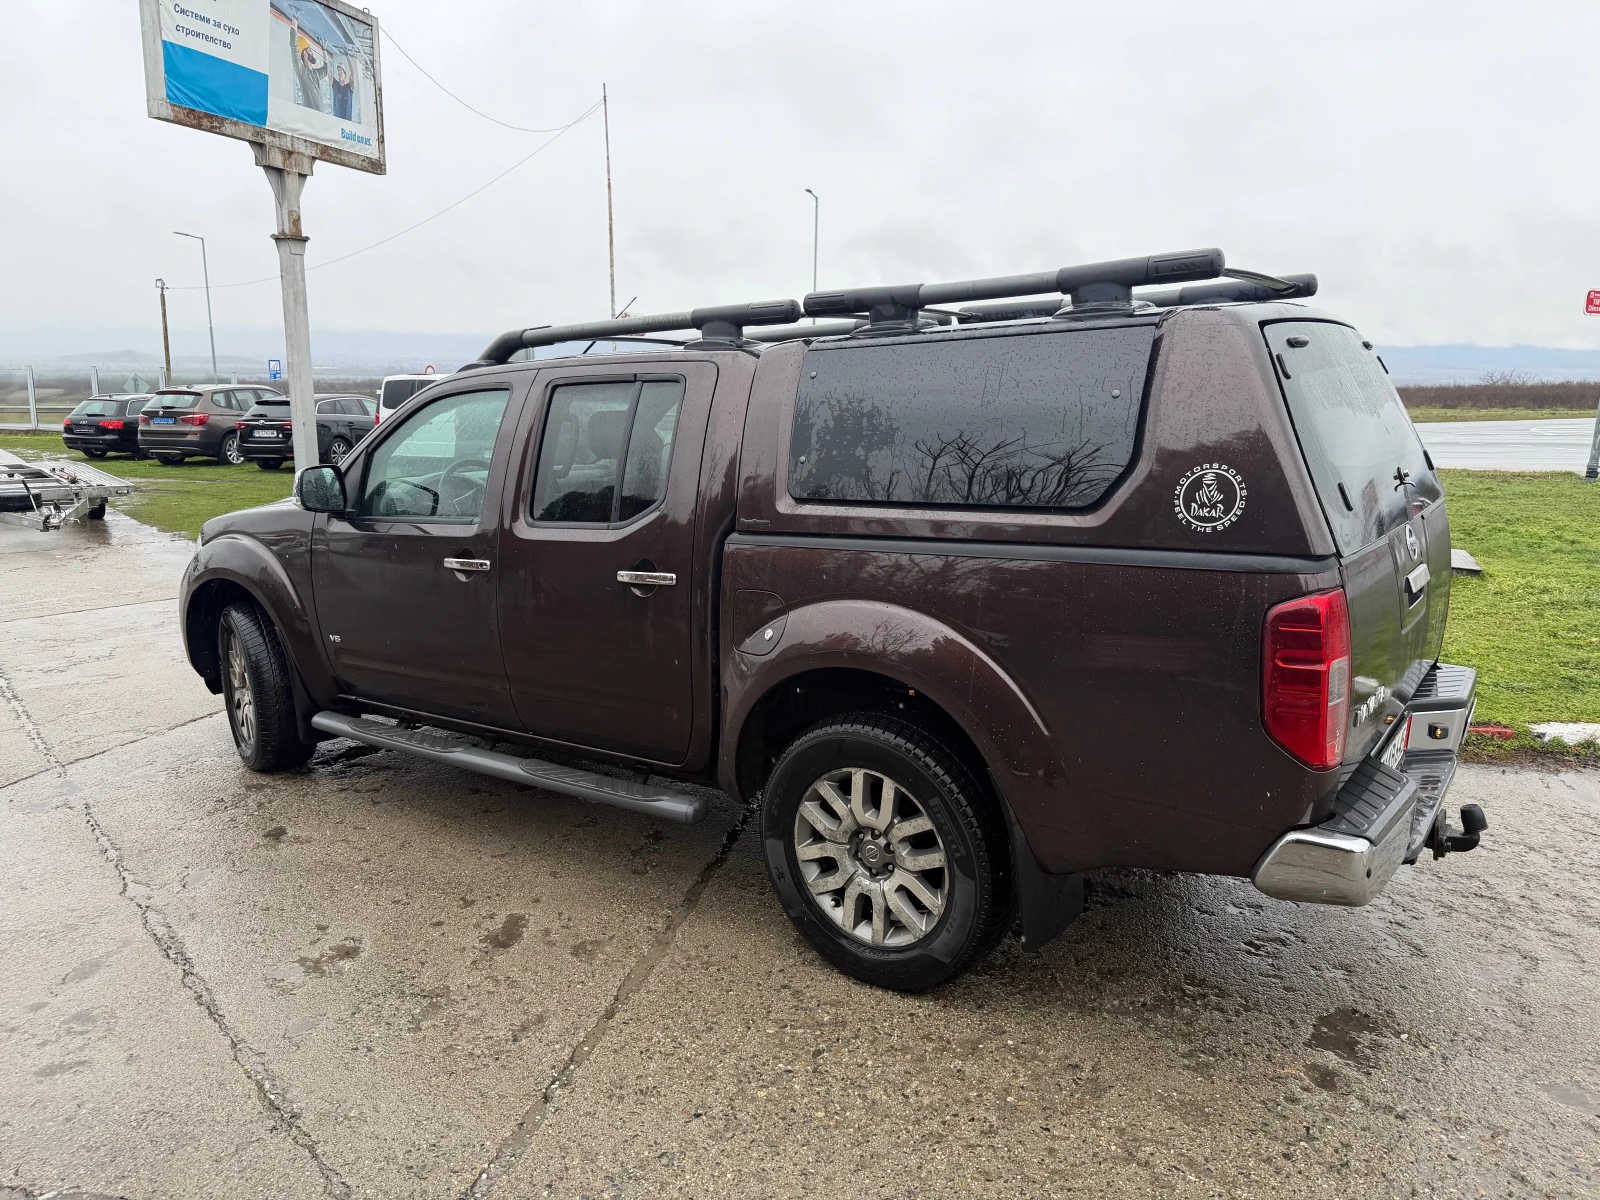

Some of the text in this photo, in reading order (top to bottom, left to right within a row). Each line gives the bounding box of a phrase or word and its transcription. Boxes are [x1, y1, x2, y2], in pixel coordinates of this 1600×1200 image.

[173, 3, 240, 36] Системи за сухо
[175, 24, 232, 50] строителство
[340, 127, 373, 147] Build on us.
[1174, 462, 1248, 497] MOTORSPORTS
[1173, 500, 1246, 533] FEEL THE SPEED
[1190, 502, 1226, 518] DAKAR
